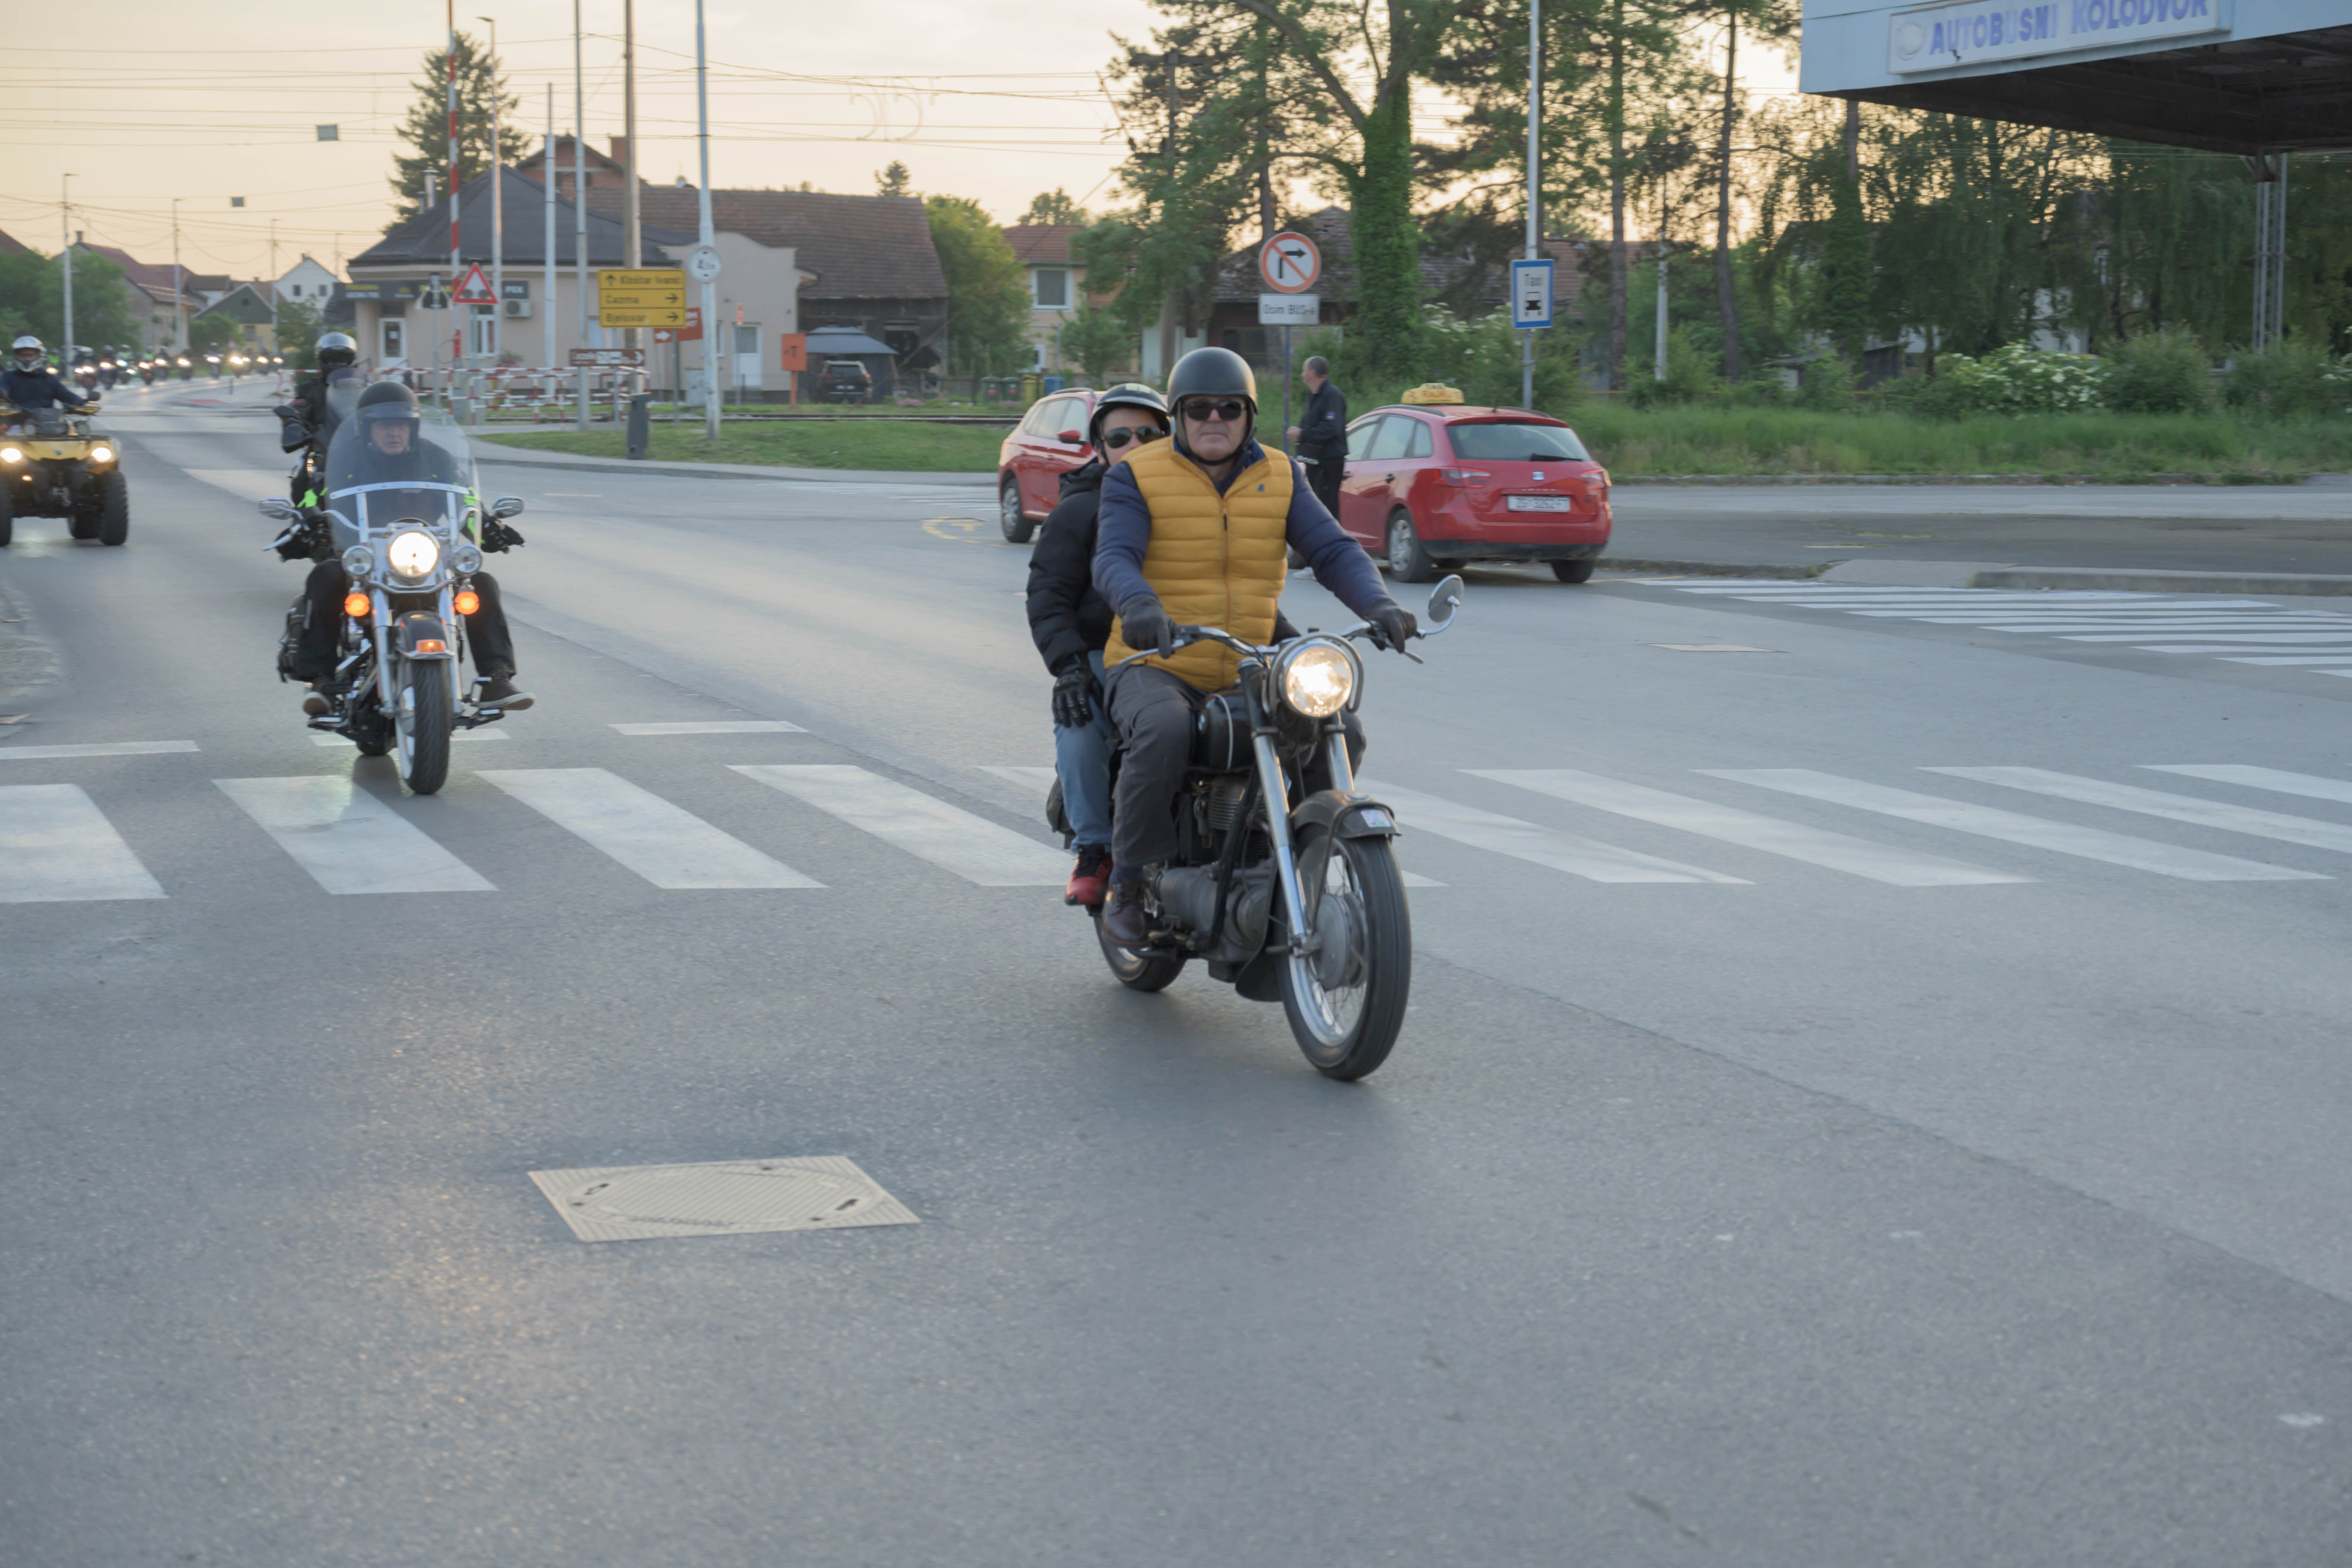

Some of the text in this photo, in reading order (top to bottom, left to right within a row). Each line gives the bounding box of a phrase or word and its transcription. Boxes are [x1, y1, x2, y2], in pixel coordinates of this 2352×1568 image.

[1928, 0, 2208, 55] AUTOBUSNI KOLODVOR
[1524, 273, 1544, 286] Taxi
